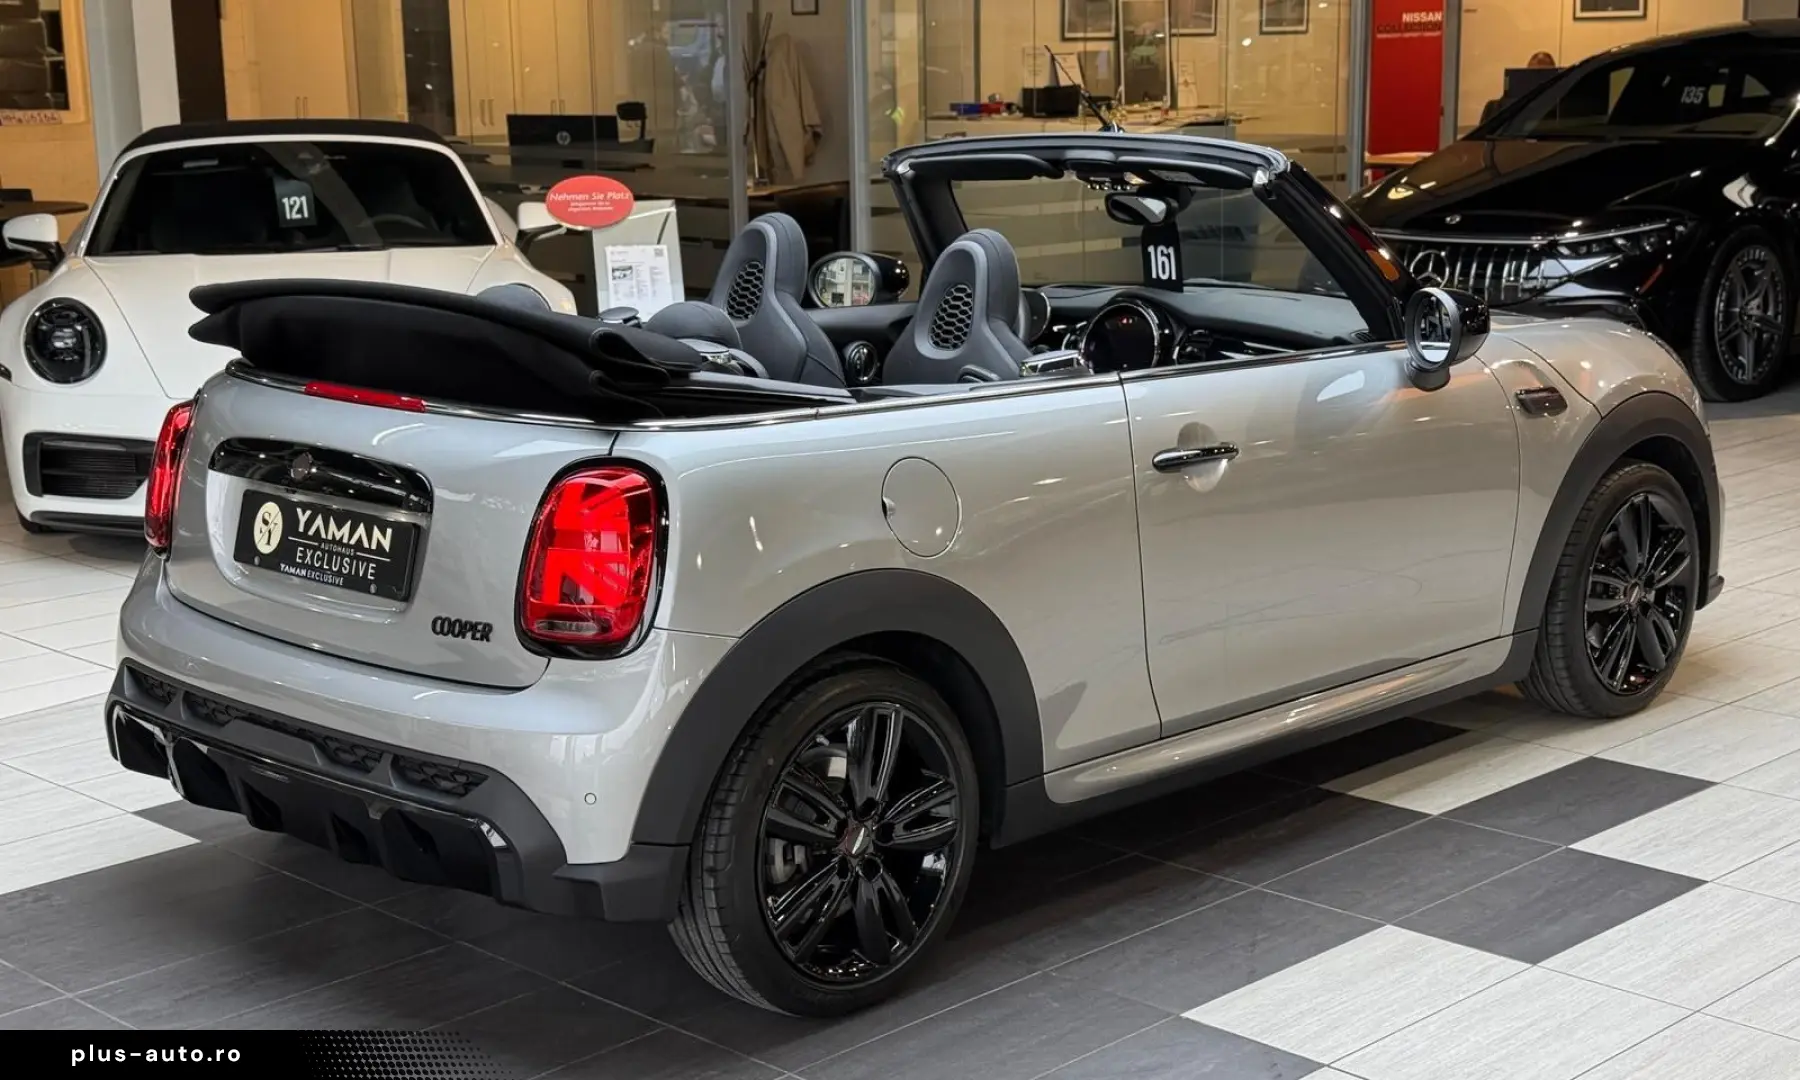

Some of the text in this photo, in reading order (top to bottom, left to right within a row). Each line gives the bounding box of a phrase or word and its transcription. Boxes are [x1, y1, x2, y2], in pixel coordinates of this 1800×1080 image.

[1402, 11, 1442, 23] NISSAN
[1681, 86, 1707, 104] 135
[281, 195, 309, 220] 121
[549, 190, 630, 201] Nehmen Sie Platz
[1147, 244, 1177, 280] 161
[296, 507, 393, 553] YAMAN
[320, 542, 355, 556] AUTOHAUS
[296, 547, 377, 580] EXCLUSIVE
[431, 615, 493, 642] COOPER
